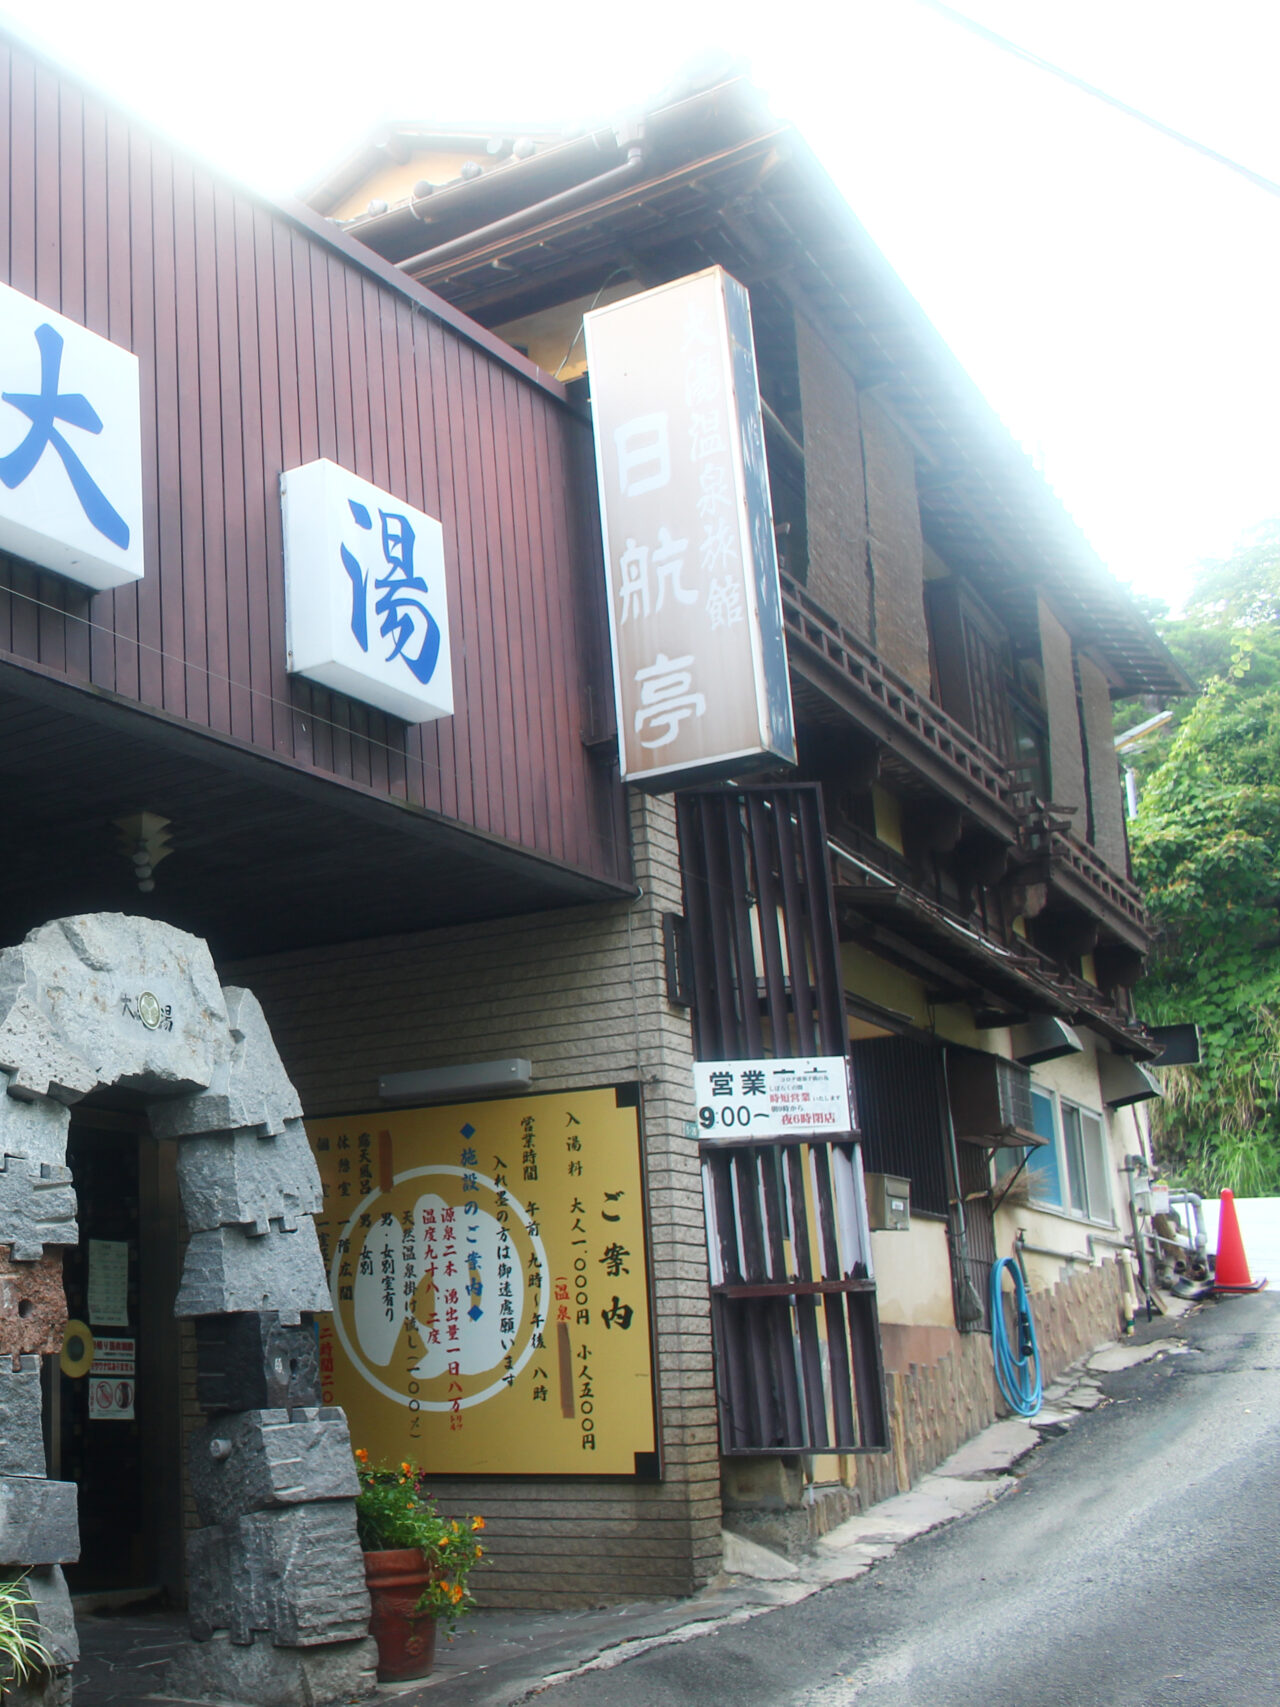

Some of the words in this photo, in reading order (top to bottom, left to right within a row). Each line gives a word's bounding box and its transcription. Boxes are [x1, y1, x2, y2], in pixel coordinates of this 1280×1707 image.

[340, 498, 441, 686] 湯
[612, 410, 708, 751] 日航亭
[565, 1111, 584, 1177] 入湯料
[520, 1116, 539, 1182] 営業時間
[532, 1366, 549, 1403] 八時
[598, 1190, 635, 1331] ご案内
